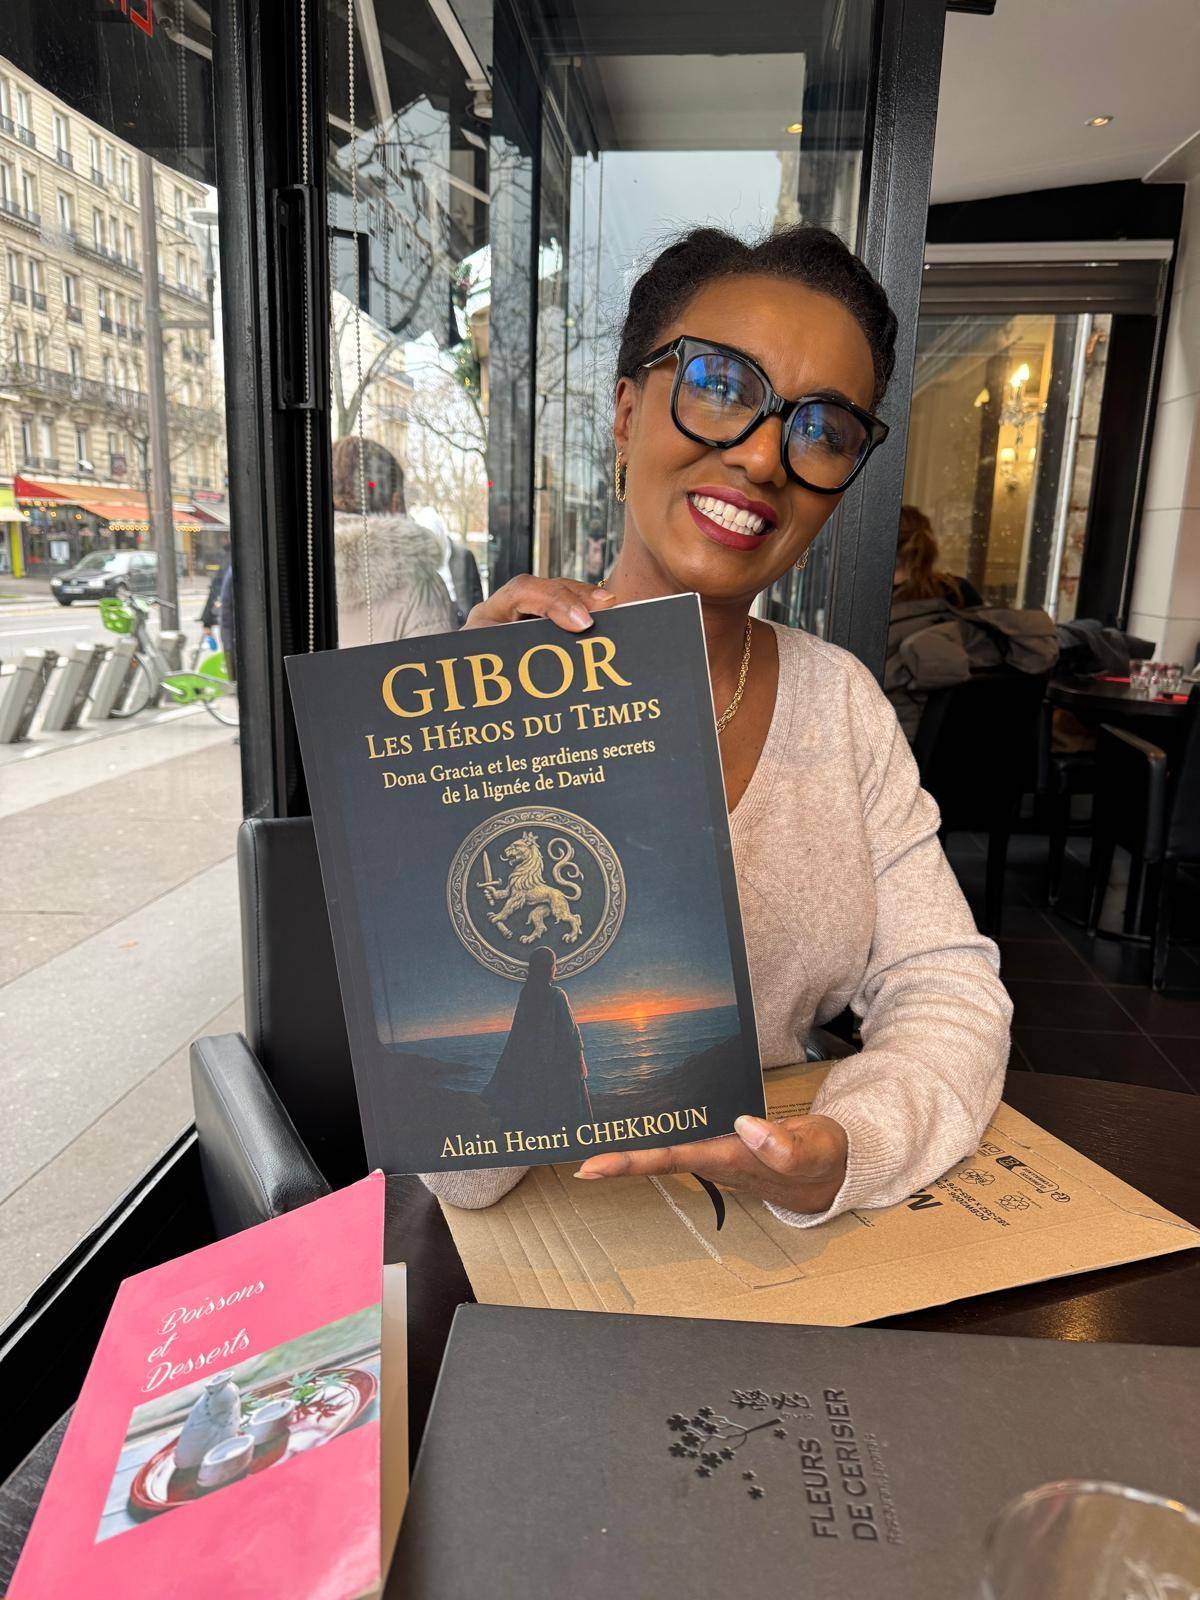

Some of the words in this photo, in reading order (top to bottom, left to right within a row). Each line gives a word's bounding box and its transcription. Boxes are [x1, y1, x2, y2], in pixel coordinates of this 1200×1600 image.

[381, 636, 633, 718] GIBOR
[382, 771, 427, 789] Dona
[430, 763, 483, 783] Gracia
[487, 760, 503, 775] et
[505, 755, 528, 773] les
[531, 748, 599, 771] gardiens
[602, 738, 656, 760] secrets
[441, 787, 462, 805] de
[465, 783, 480, 801] la
[483, 776, 532, 802] lignée
[534, 773, 555, 791] de
[558, 765, 606, 788] David
[440, 1134, 499, 1158] Alain
[504, 1127, 569, 1153] Henri
[576, 1106, 709, 1147] CHEKROUN
[157, 1280, 264, 1335] Boissons
[141, 1328, 250, 1393] Desserts
[147, 1332, 179, 1363] et
[823, 1387, 868, 1498] CERISIER
[799, 1436, 839, 1539] FLEURS
[847, 1503, 879, 1542] DE
